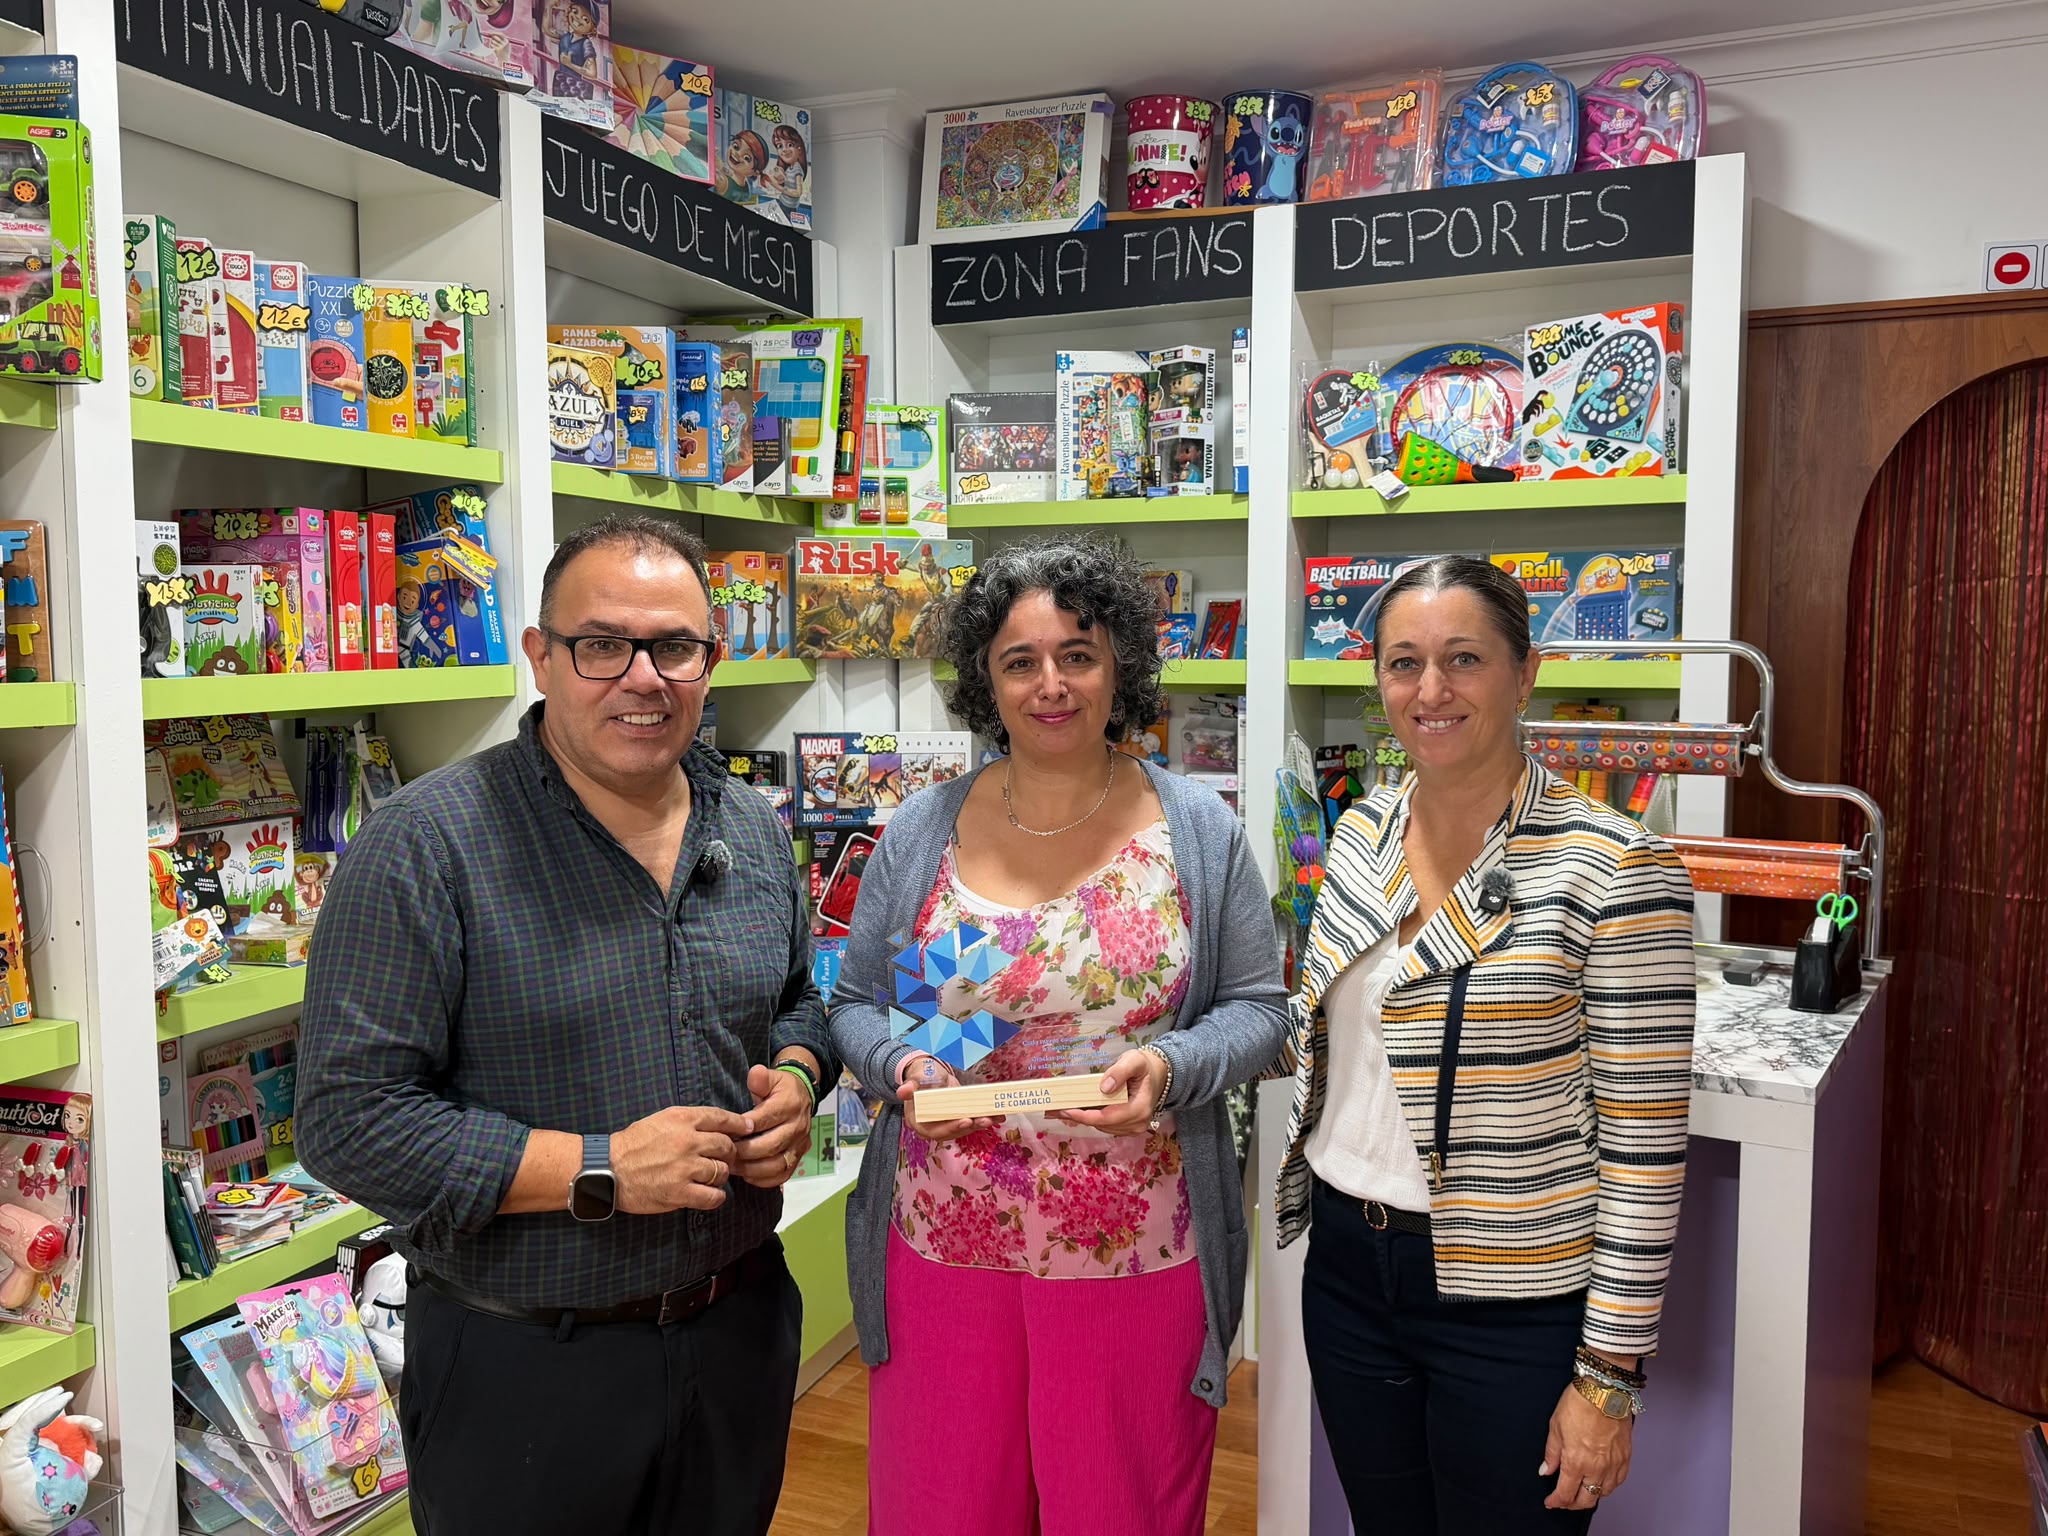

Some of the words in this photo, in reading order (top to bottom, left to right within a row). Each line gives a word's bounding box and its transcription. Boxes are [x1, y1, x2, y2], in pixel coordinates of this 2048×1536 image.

[59, 60, 74, 70] 3+
[687, 78, 709, 92] 10€
[1005, 104, 1060, 118] Ravensburger
[1061, 102, 1087, 113] Puzzle
[1392, 97, 1411, 110] 13€
[944, 112, 966, 124] 3000
[29, 128, 51, 136] AGES
[56, 130, 66, 138] 3+
[546, 137, 659, 243] JUEGO
[674, 194, 714, 262] DE
[724, 217, 798, 302] MESA
[1331, 184, 1631, 271] DEPORTES
[182, 256, 215, 277] 12€
[942, 239, 1089, 307] ZONA
[1124, 221, 1246, 287] FANS
[308, 280, 354, 299] Puzzle
[320, 302, 347, 317] XXL
[455, 296, 480, 312] 16€
[266, 310, 302, 327] 12€
[317, 320, 329, 330] 3+
[562, 328, 598, 338] RANAS
[563, 338, 624, 348] CAZABOLAS
[774, 339, 790, 347] PCS
[1527, 322, 1605, 379] BOUNCE
[134, 368, 147, 388] 6
[726, 372, 746, 384] 15€
[1060, 380, 1070, 411] Puzzle
[1206, 376, 1214, 410] HATTER
[548, 396, 592, 415] AZUL
[560, 418, 581, 428] DUEL
[1060, 412, 1072, 475] Ravensburger
[1667, 418, 1676, 470] BOUNCE
[1205, 444, 1213, 479] MOANA
[764, 480, 782, 488] cayro
[966, 477, 988, 490] 15€
[462, 494, 478, 512] 10€
[224, 519, 252, 532] 10€
[798, 540, 900, 576] Risk
[1628, 558, 1651, 571] 10€
[1310, 564, 1391, 583] BASKETBALL
[1521, 559, 1564, 578] Ball
[158, 585, 183, 600] 15€
[744, 584, 760, 598] 8€
[186, 600, 236, 610] plasticine
[168, 719, 189, 734] fun
[208, 722, 225, 738] 5€
[232, 726, 260, 740] ough
[164, 728, 201, 745] dough
[800, 738, 844, 755] MARVEL
[873, 740, 893, 750] 12€
[732, 758, 750, 770] 12€
[182, 806, 198, 816] CLAY
[802, 813, 822, 822] 1000
[994, 1088, 1050, 1100] CONCEJALÍA
[994, 1101, 1006, 1109] DE
[1008, 1096, 1052, 1108] COMERCIO
[28, 1103, 60, 1126] Set
[8, 1126, 34, 1134] FASHION
[34, 1128, 47, 1136] GIRL
